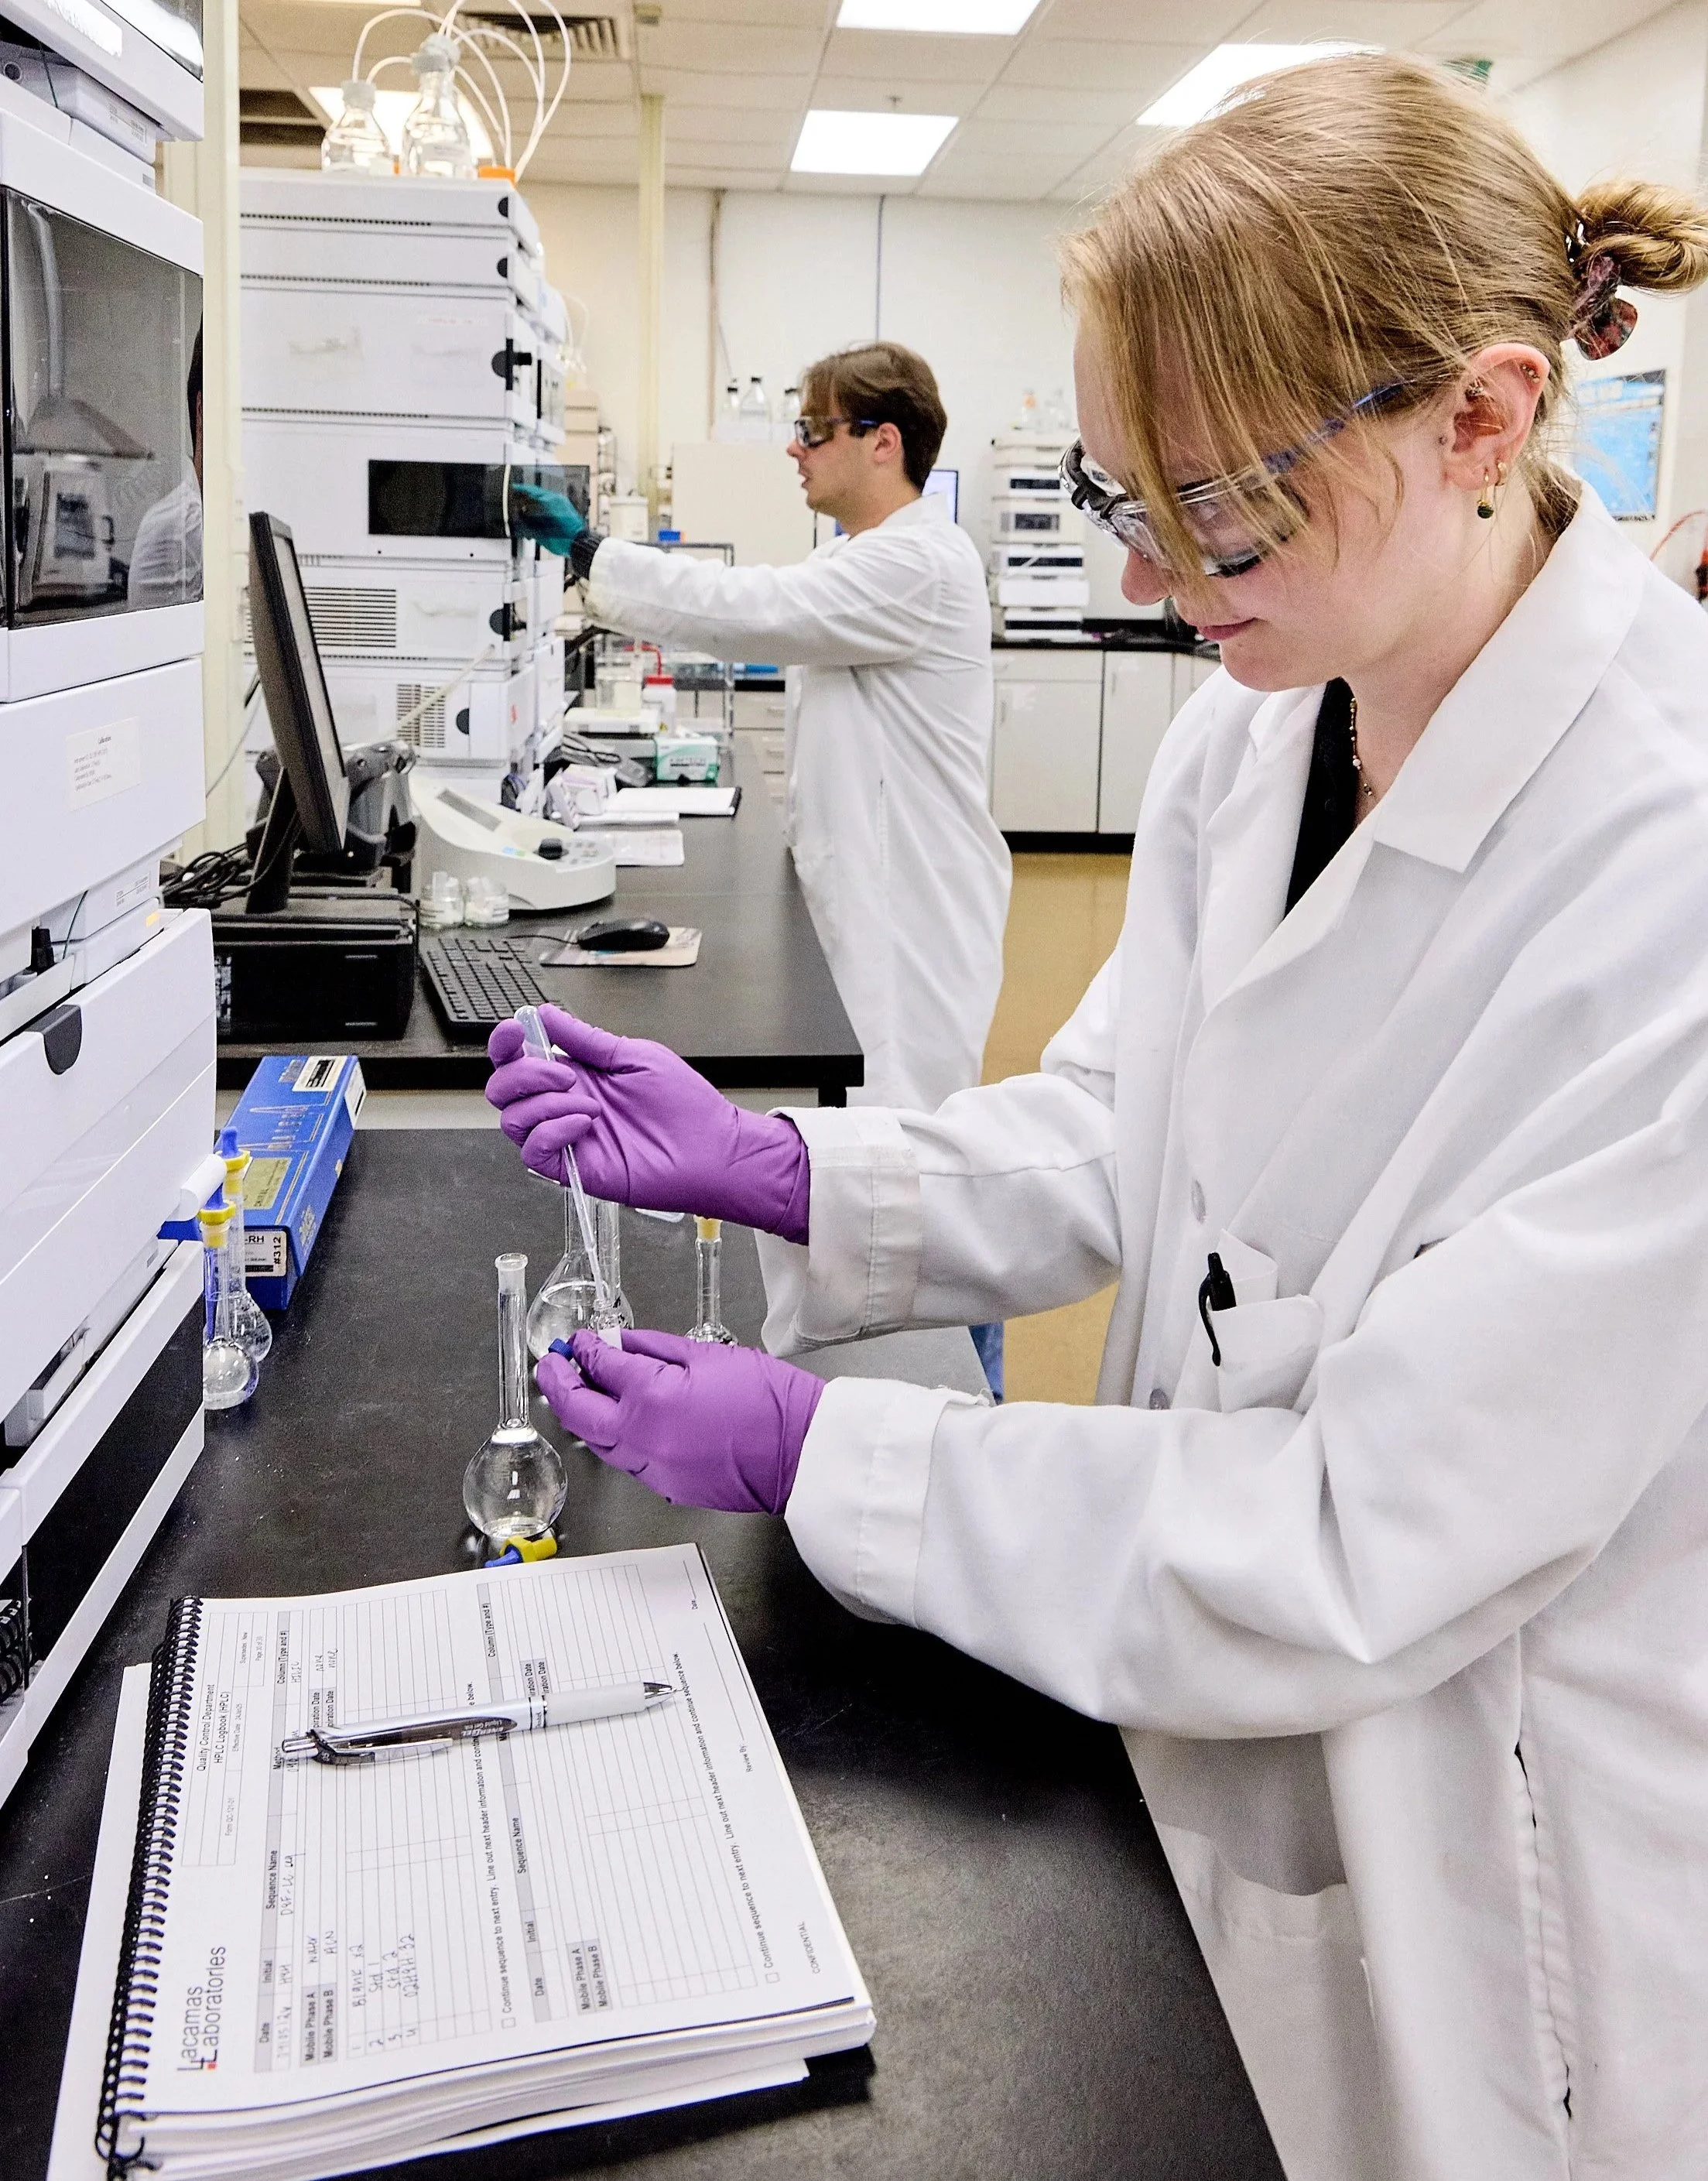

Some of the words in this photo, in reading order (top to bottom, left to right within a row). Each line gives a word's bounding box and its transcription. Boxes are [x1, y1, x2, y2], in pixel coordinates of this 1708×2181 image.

[483, 1608, 491, 1618] and
[484, 1619, 495, 1635] (Type
[279, 1635, 288, 1646] and
[487, 1636, 496, 1657] Column
[278, 1646, 289, 1662] (Type
[276, 1662, 286, 1683] Column
[524, 1662, 533, 1676] Date
[537, 1661, 546, 1674] Date
[678, 1669, 692, 1696] sequence
[202, 1683, 216, 1719] Department
[218, 1690, 231, 1713] (HPLC)
[312, 1691, 320, 1704] Date
[326, 1690, 334, 1703] Date
[312, 1705, 320, 1727] piration
[326, 1703, 335, 1727] piration
[686, 1697, 699, 1721] continue
[199, 1720, 211, 1745] Control
[215, 1714, 229, 1742] Logbook
[693, 1722, 703, 1734] and
[214, 1744, 224, 1762] HPLC
[473, 1735, 482, 1757] contin
[697, 1734, 713, 1770] information
[197, 1747, 212, 1771] Quality
[474, 1758, 483, 1769] and
[743, 1752, 754, 1772] Review
[477, 1771, 488, 1808] information
[708, 1771, 721, 1793] header
[714, 1793, 725, 1809] next
[480, 1810, 491, 1832] header
[511, 1816, 521, 1836] Name
[719, 1810, 729, 1821] out
[482, 1833, 492, 1849] next
[724, 1823, 734, 1838] Line
[268, 1849, 278, 1870] Name
[484, 1851, 494, 1862] out
[514, 1838, 526, 1873] Sequence
[730, 1841, 742, 1862] entry.
[486, 1864, 496, 1881] Line
[736, 1864, 747, 1880] next
[265, 1872, 278, 1909] Sequence
[489, 1884, 501, 1905] entry.
[742, 1881, 750, 1890] to
[491, 1906, 501, 1923] next
[744, 1891, 762, 1928] sequence
[494, 1925, 502, 1933] to
[525, 1920, 536, 1942] Initial
[495, 1935, 509, 1973] sequence
[756, 1930, 773, 1967] Continue
[796, 1920, 821, 1974] CONFIDENTIAL
[262, 1959, 272, 1983] Initial
[574, 1955, 586, 1981] Phase
[591, 1953, 603, 1977] Phase
[501, 1975, 512, 2012] Continue
[535, 1976, 545, 1996] Date
[580, 1983, 591, 2009] Mobile
[596, 1979, 608, 2006] Mobile
[190, 1945, 227, 2062] Laboratories
[304, 2000, 316, 2028] Phase
[323, 1998, 334, 2025] Phase
[176, 1985, 204, 2070] Lacamas
[258, 2022, 270, 2042] Date
[304, 2030, 316, 2060] Mobile
[323, 2028, 334, 2057] Mobile
